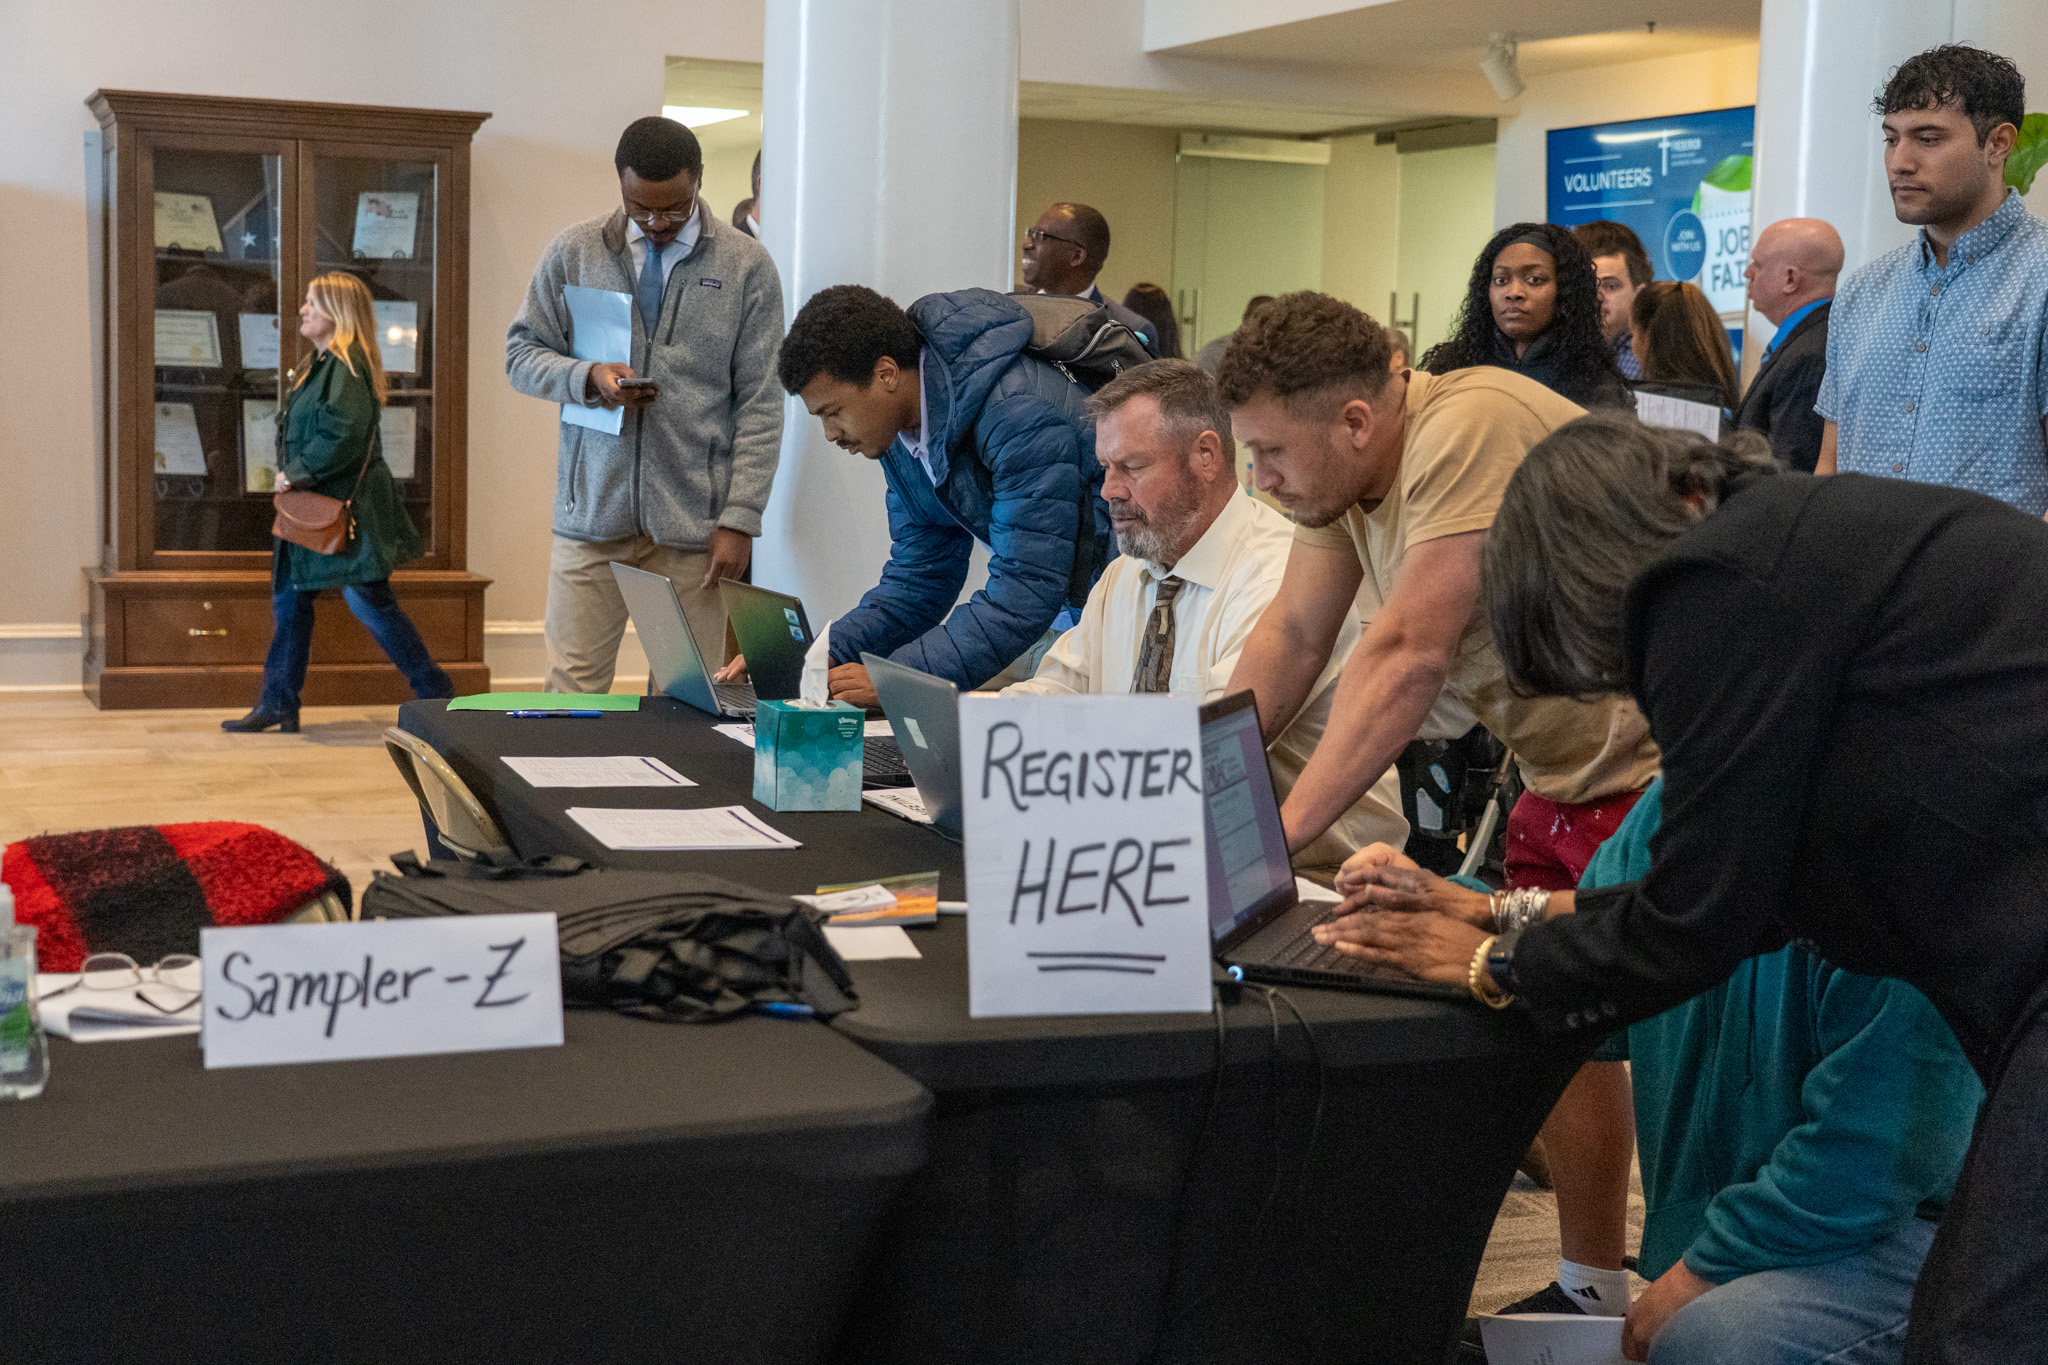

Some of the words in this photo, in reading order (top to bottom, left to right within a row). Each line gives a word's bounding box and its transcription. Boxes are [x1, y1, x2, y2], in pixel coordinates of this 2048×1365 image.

[1563, 166, 1653, 193] VOLUNTEERS
[1715, 225, 1749, 257] JOB
[1711, 260, 1747, 292] FAI
[982, 720, 1201, 812] REGISTER
[1009, 837, 1191, 927] HERE
